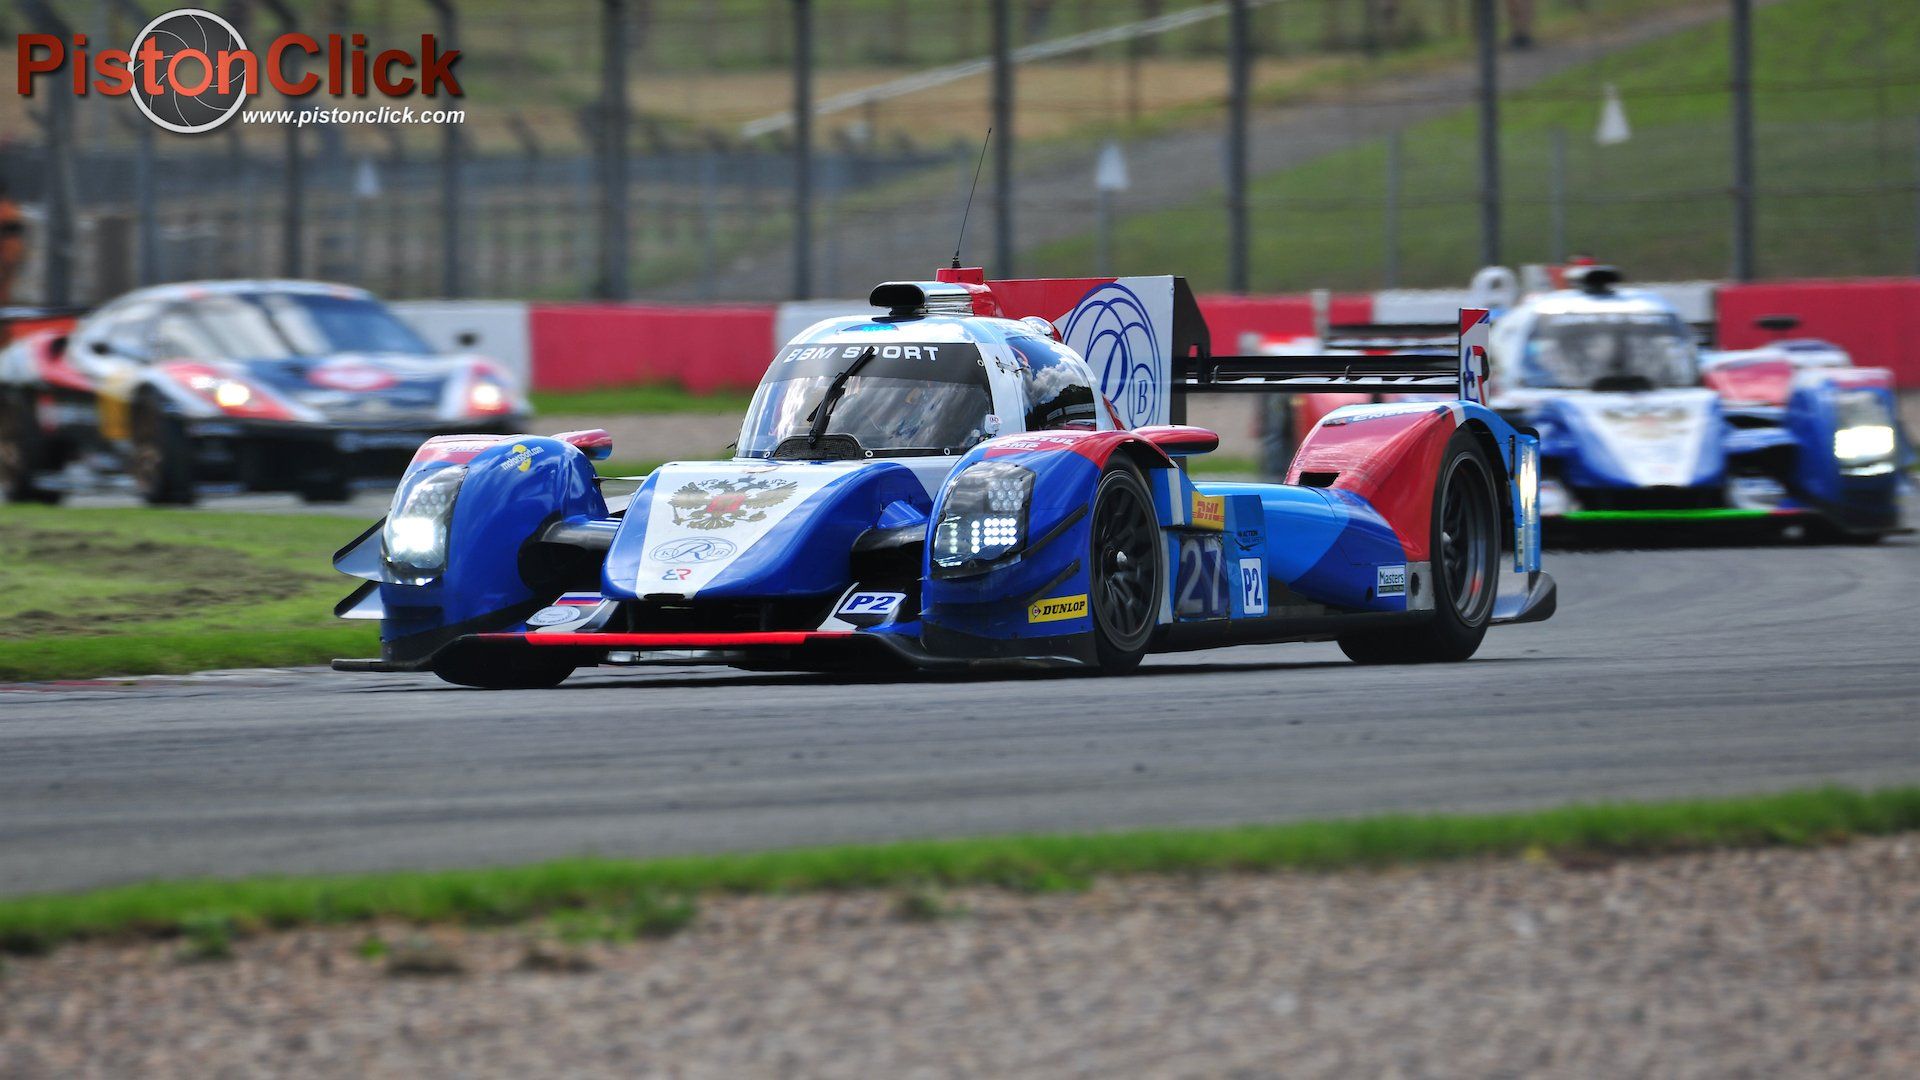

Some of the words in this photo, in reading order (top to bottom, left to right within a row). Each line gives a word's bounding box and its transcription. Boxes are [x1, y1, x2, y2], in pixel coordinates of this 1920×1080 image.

[783, 346, 838, 363] BBM
[500, 445, 545, 471] motorsport.com
[1195, 500, 1221, 521] DHL
[1177, 535, 1223, 615] 27
[1379, 570, 1404, 585] Masters
[1243, 567, 1262, 606] P2
[846, 595, 897, 611] P2
[1042, 600, 1086, 616] DUNLOP
